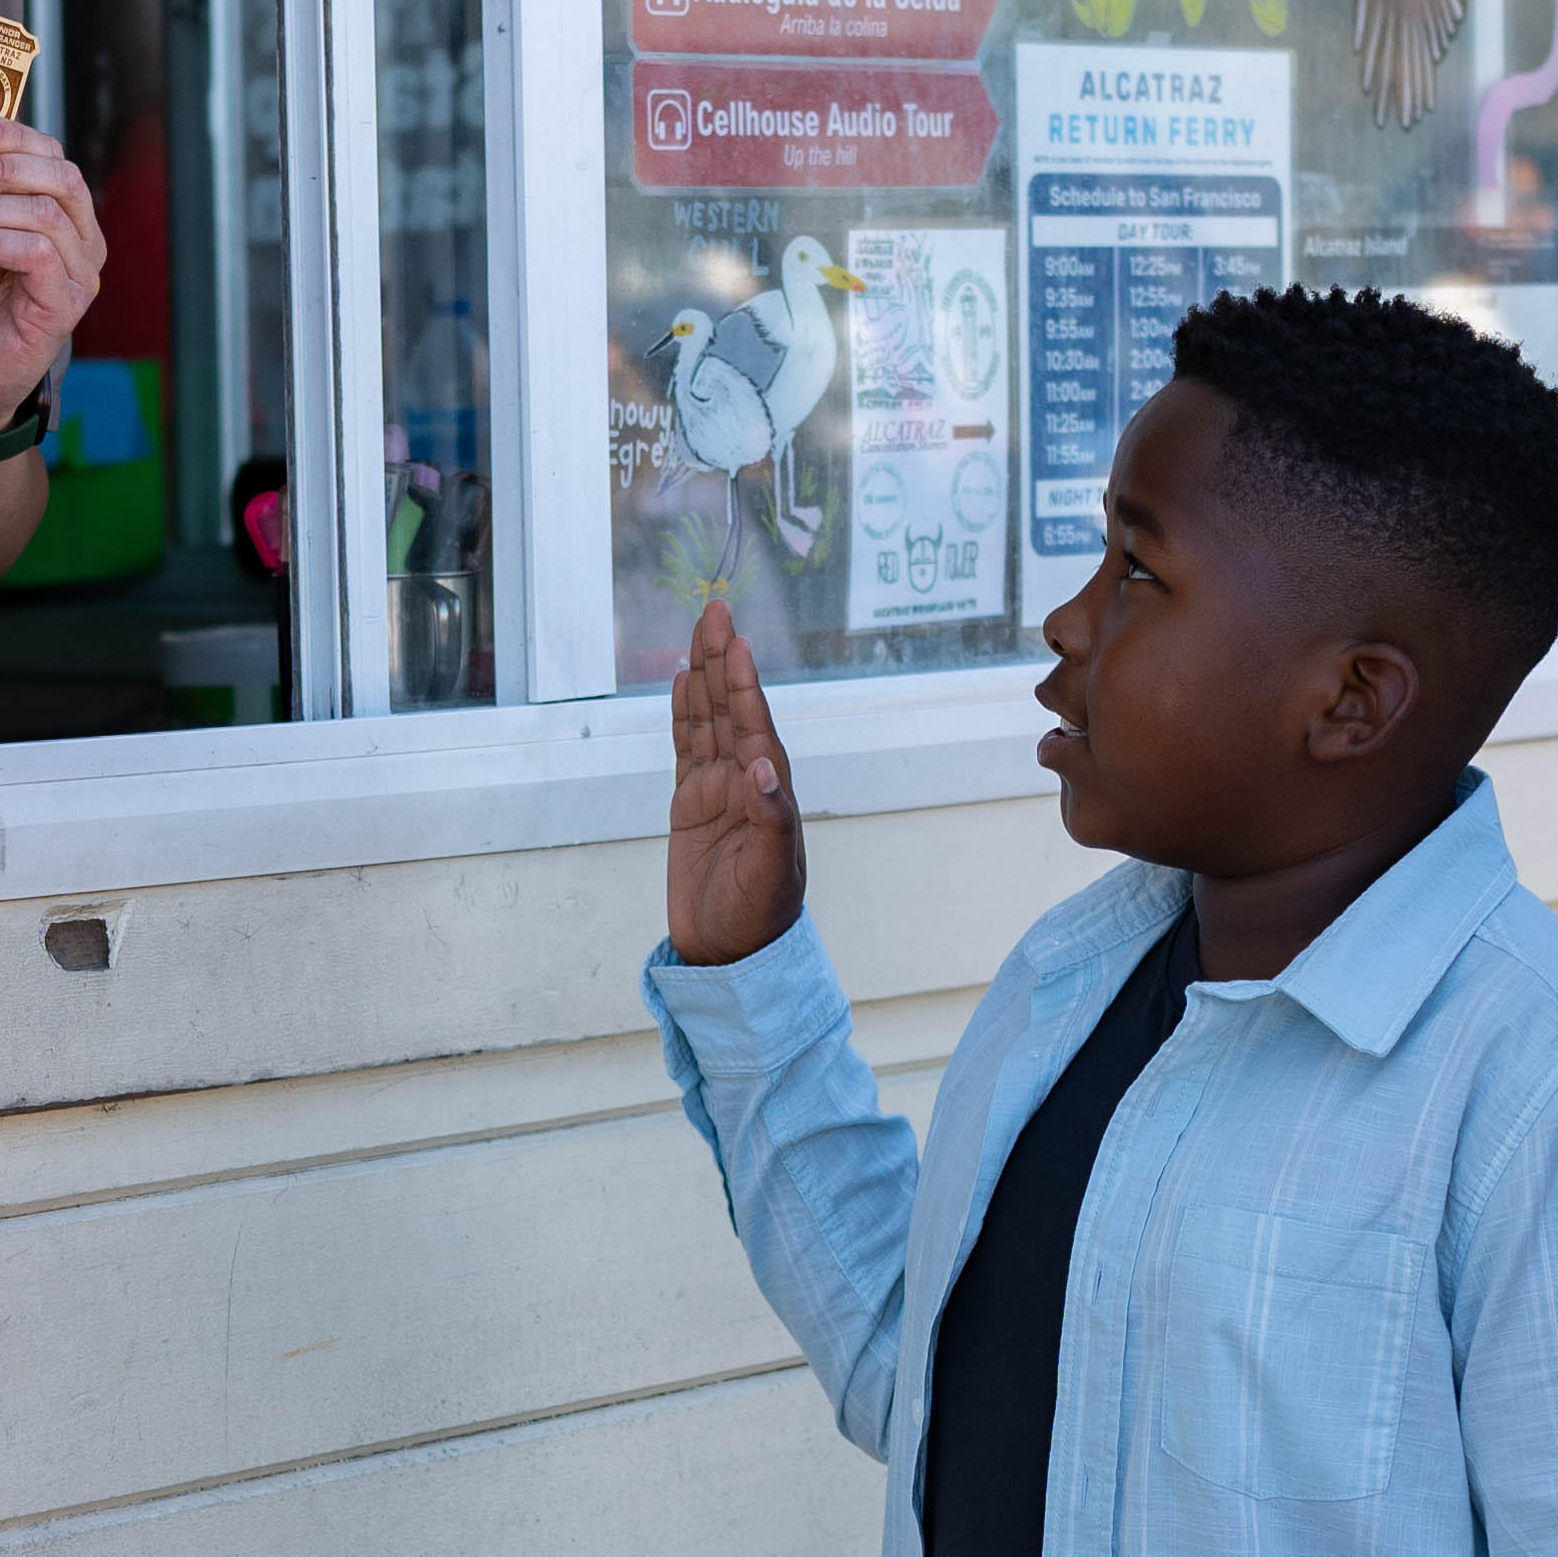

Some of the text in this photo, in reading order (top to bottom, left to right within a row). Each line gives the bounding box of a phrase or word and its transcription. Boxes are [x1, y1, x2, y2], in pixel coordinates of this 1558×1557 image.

[780, 14, 888, 38] Arriba la colina
[0, 72, 11, 92] GATE
[1079, 71, 1223, 104] ALCATRAZ
[697, 101, 954, 138] Cellhouse Audio Tour
[1048, 113, 1255, 147] RETURN FERRY
[783, 144, 857, 169] Up the hill
[1050, 186, 1262, 209] Schedule to San Francisco
[673, 198, 780, 234] WESTERN
[1117, 223, 1148, 241] DAY
[1044, 256, 1095, 277] 9:00AM
[1045, 380, 1096, 403] 11:00AM
[1047, 488, 1092, 507] NIGHT
